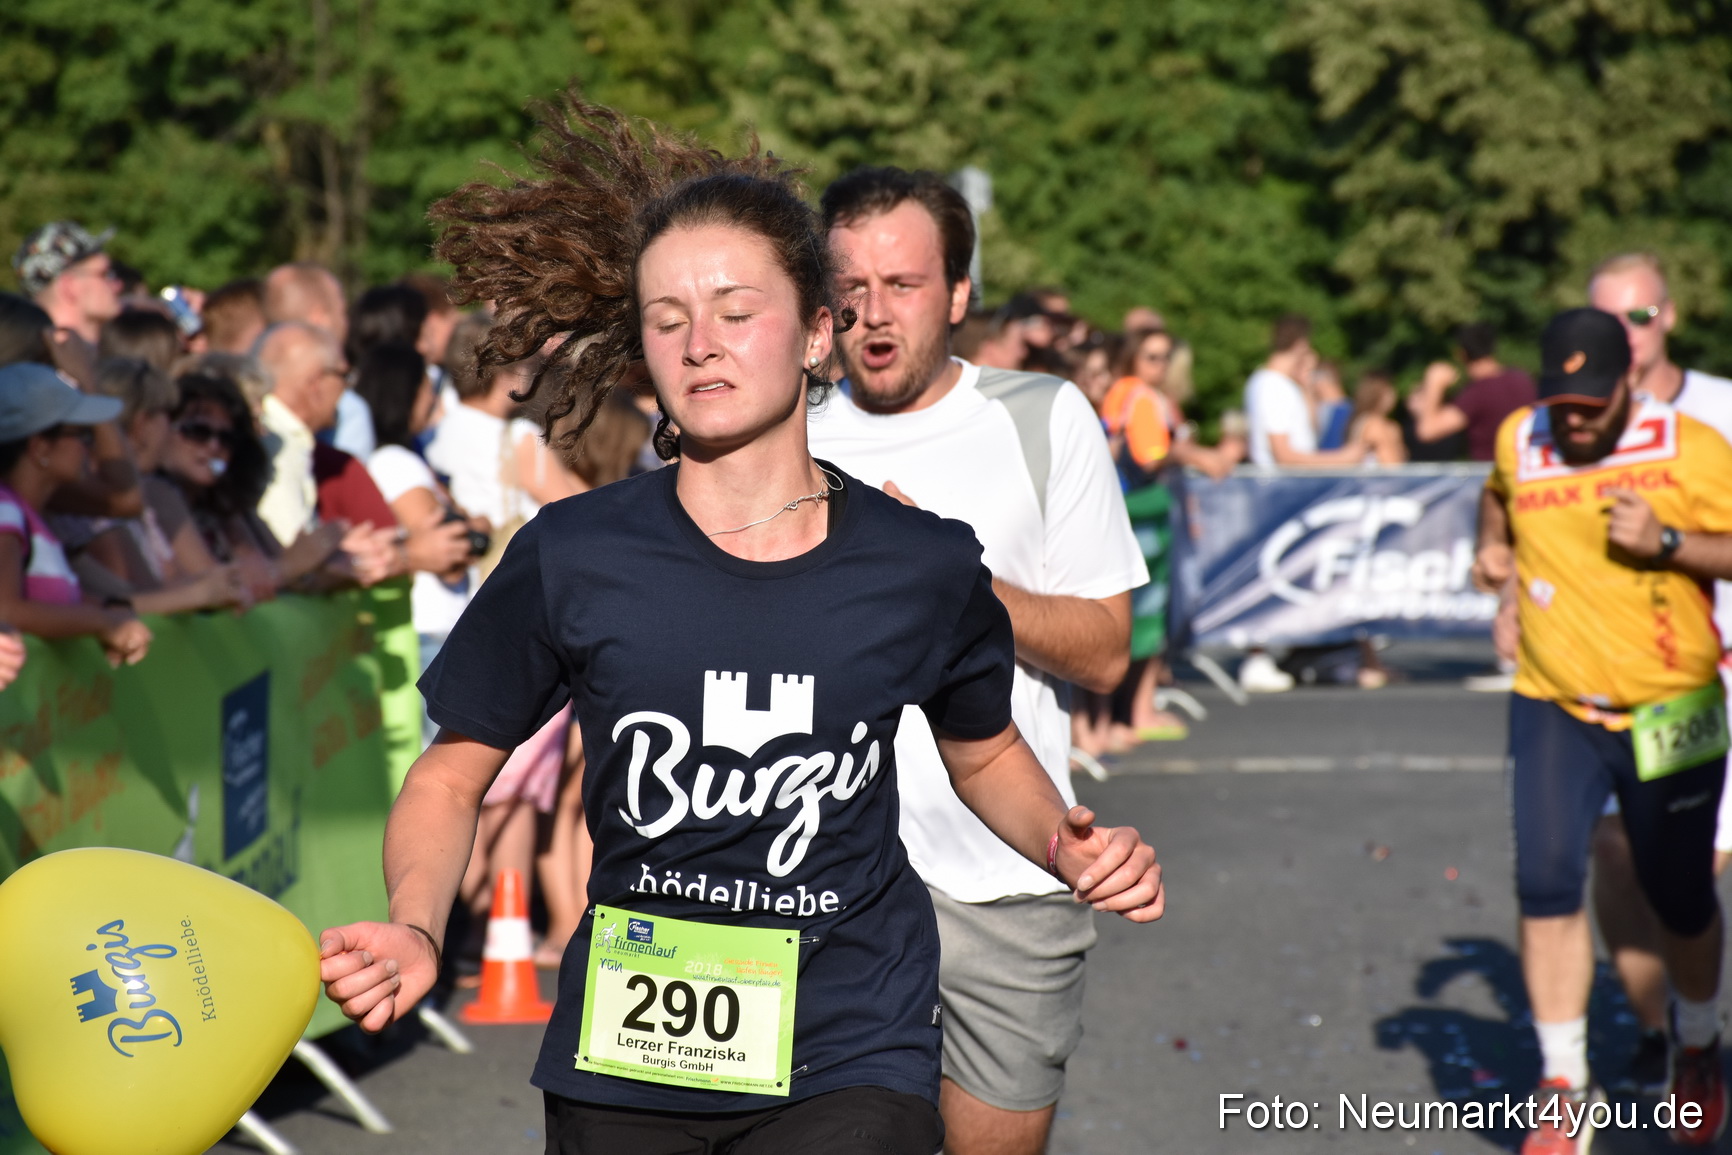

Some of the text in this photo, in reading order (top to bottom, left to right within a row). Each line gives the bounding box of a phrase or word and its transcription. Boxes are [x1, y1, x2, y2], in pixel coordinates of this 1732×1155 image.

[1515, 485, 1581, 512] MAX
[611, 711, 880, 877] Burgis
[614, 936, 678, 959] firmenlauf
[180, 914, 217, 1022] Knödelliebe.
[684, 960, 723, 976] 2018
[86, 919, 182, 1057] Burgis
[622, 974, 740, 1043] 290
[617, 1033, 747, 1062] Lerzer Franziska
[642, 1054, 714, 1072] Burgis GmbH
